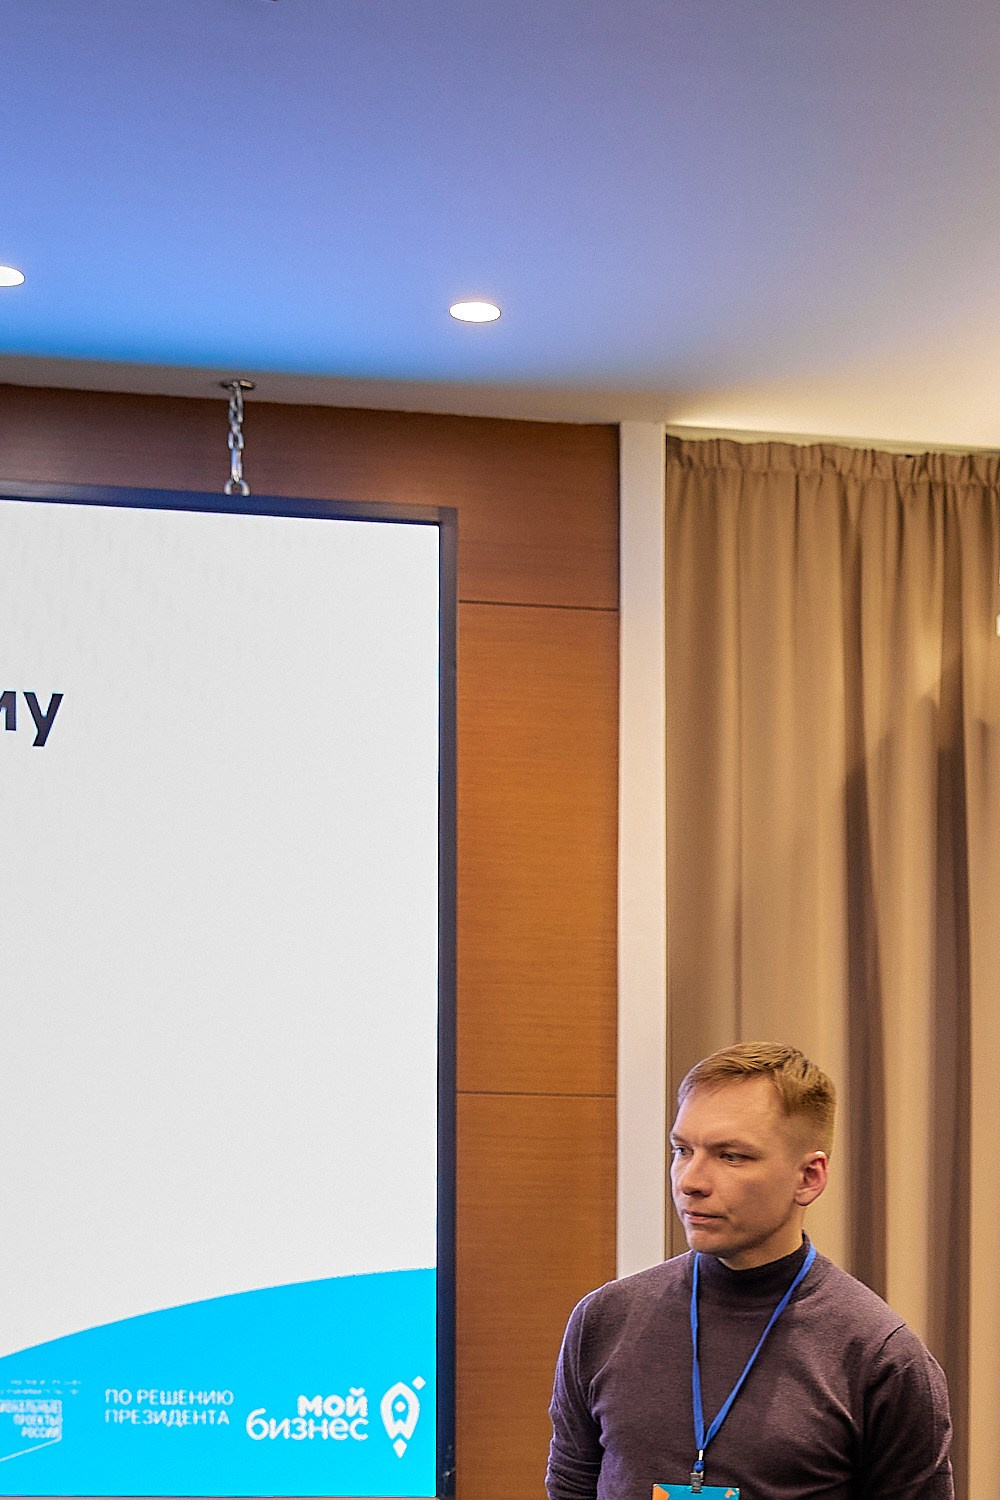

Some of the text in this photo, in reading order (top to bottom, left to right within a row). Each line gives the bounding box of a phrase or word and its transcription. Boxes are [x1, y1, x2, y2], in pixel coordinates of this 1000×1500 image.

[105, 1388, 234, 1405] ПО РЕШЕНИЮ
[297, 1387, 368, 1417] мой
[104, 1408, 230, 1427] ПРЕЗИДЕНТА
[245, 1407, 369, 1441] бизнес
